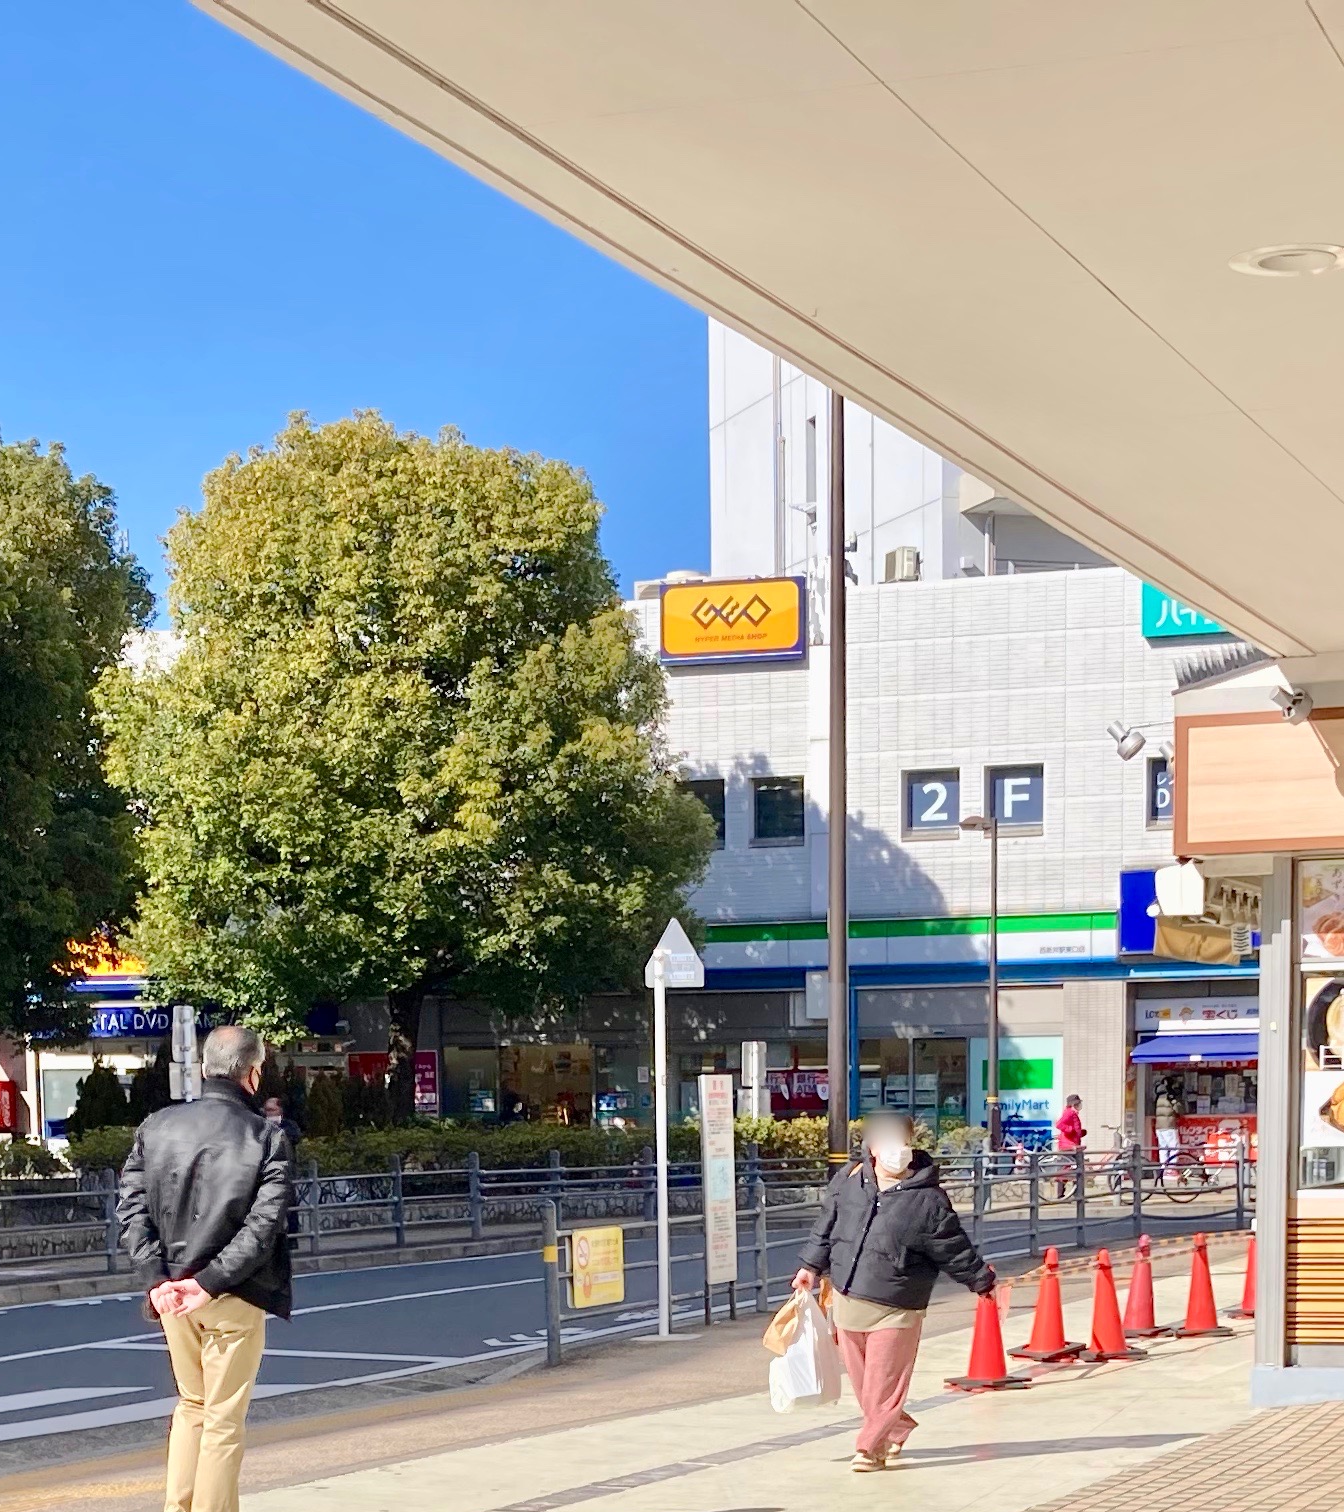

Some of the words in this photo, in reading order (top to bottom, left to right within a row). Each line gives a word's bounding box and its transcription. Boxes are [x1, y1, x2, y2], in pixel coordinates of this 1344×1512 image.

[690, 594, 771, 629] GEO
[1202, 1009, 1238, 1020] 宝くじ
[983, 1099, 1050, 1114] FmilyMart
